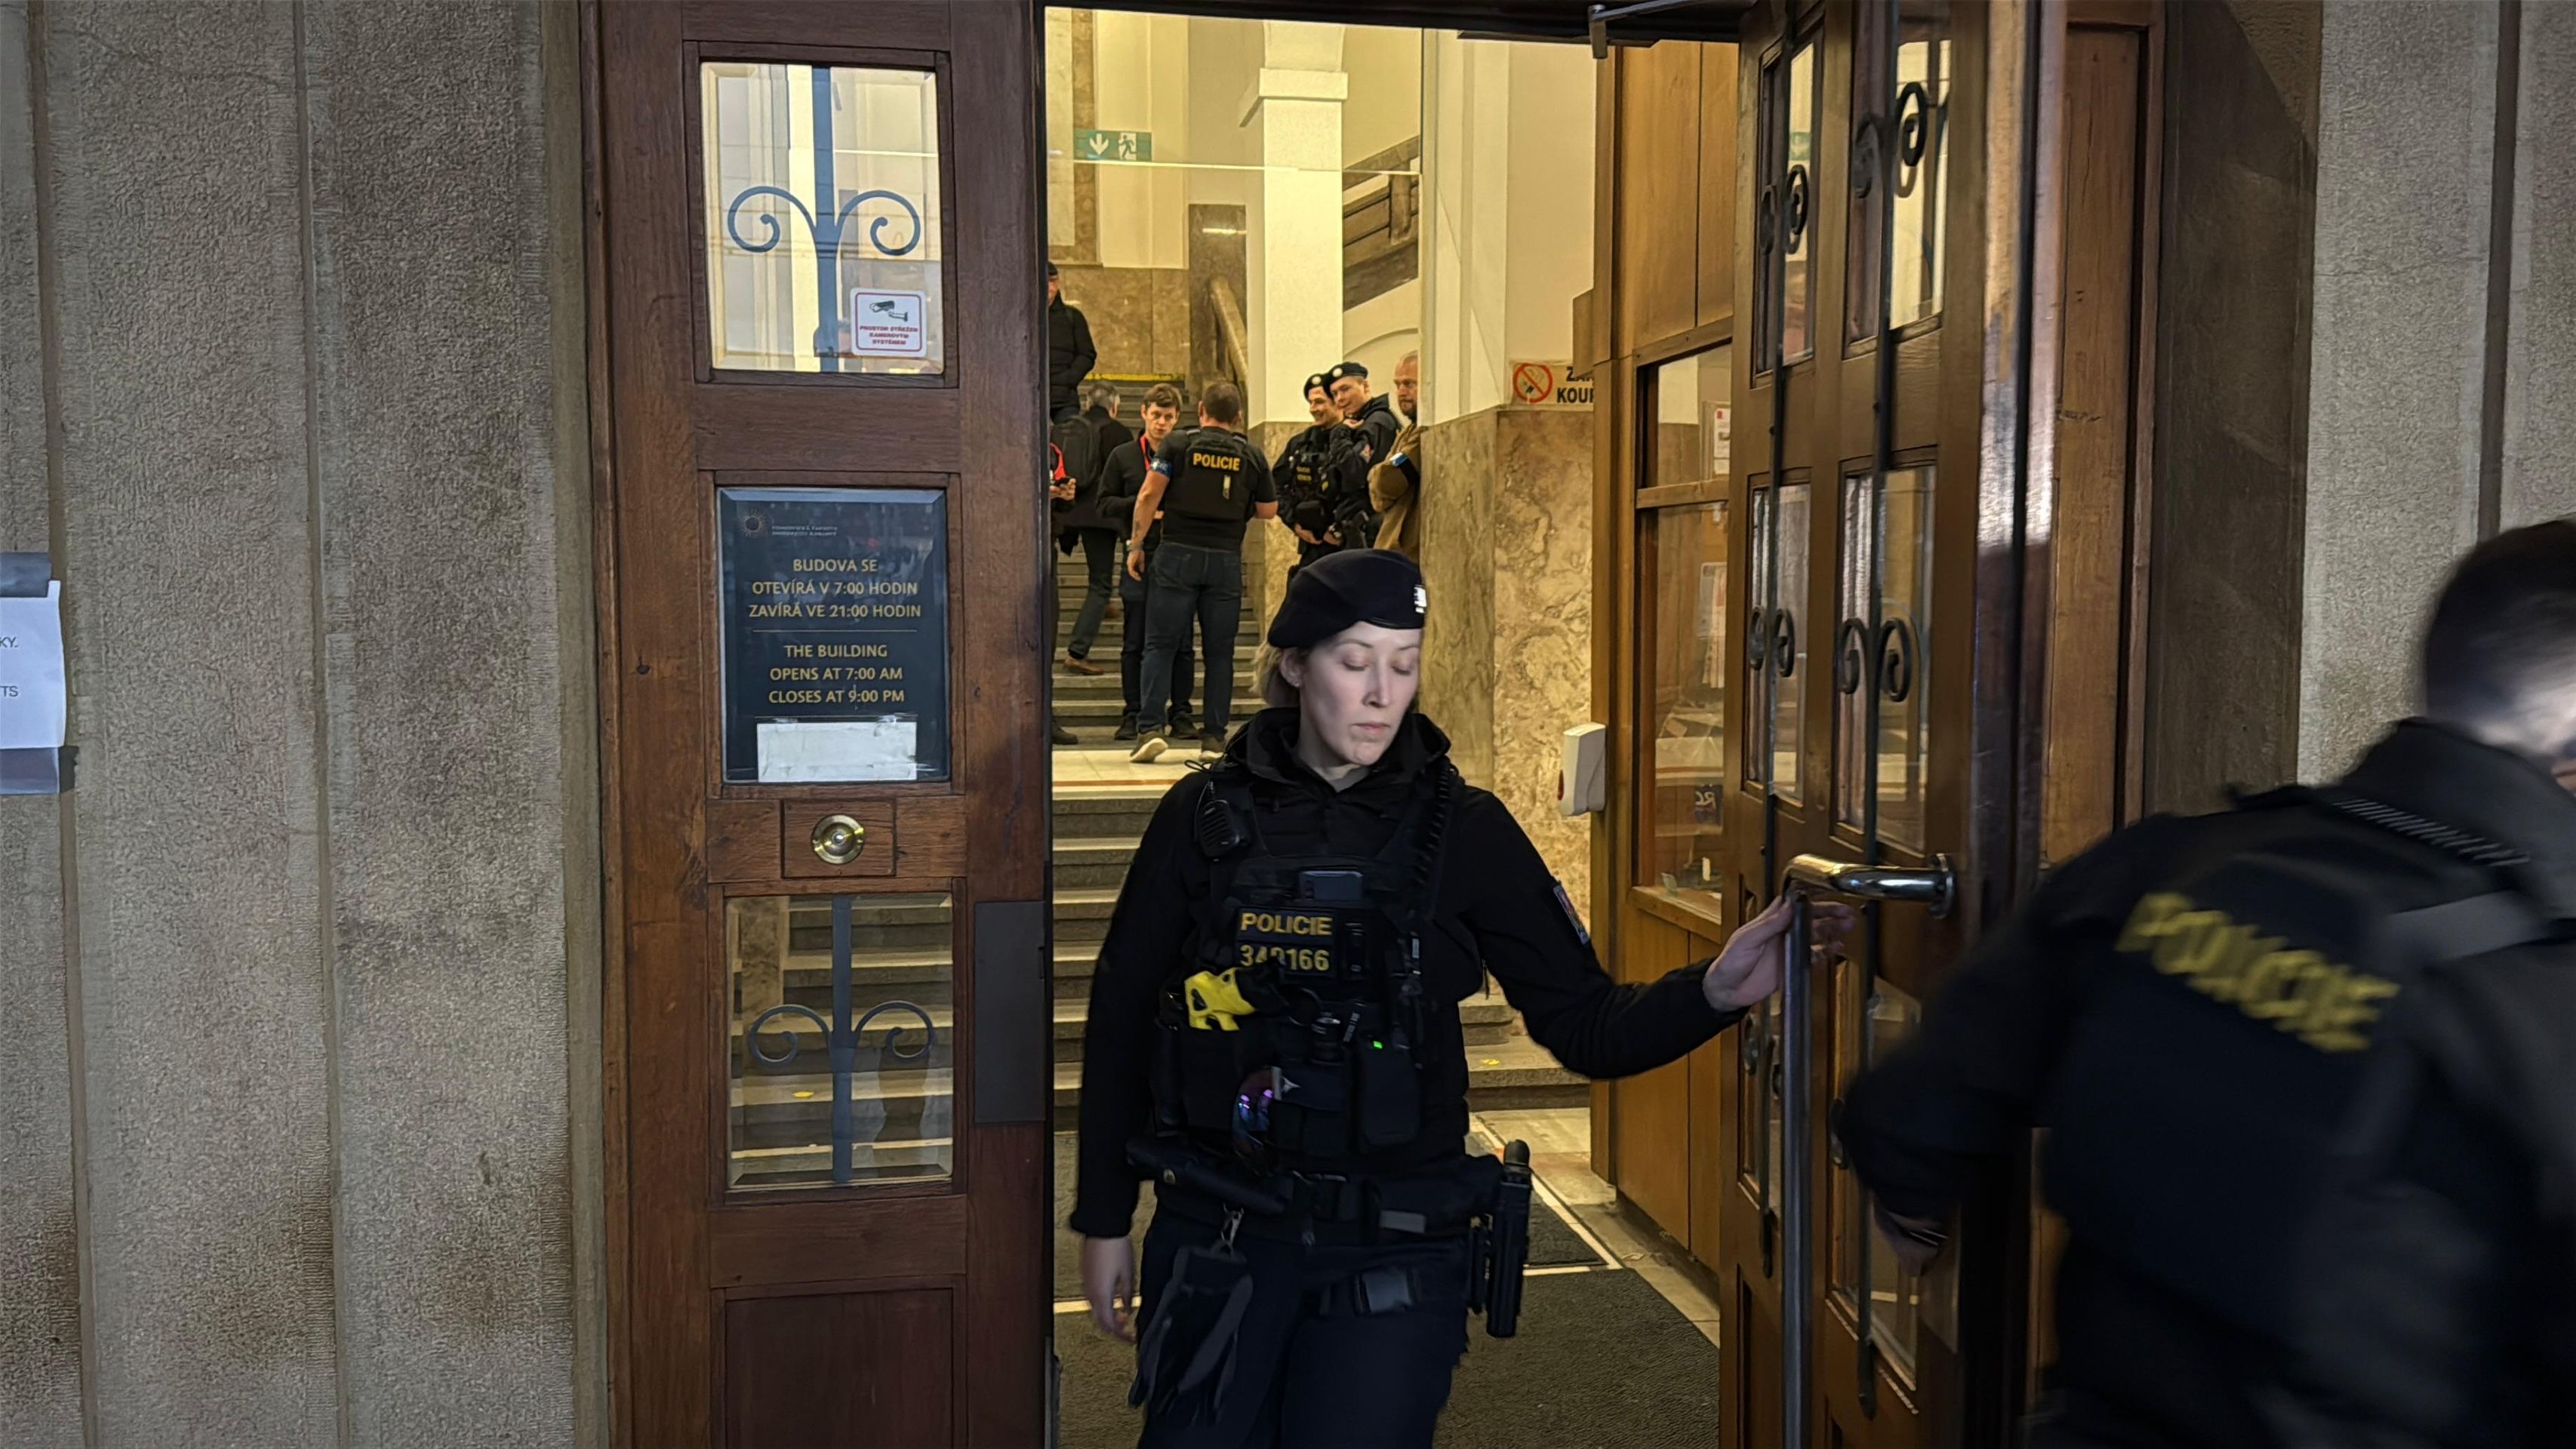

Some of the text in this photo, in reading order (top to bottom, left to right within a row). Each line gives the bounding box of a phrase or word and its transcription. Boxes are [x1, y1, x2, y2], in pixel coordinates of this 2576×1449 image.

[1193, 453, 1241, 471] POLICIE
[792, 558, 879, 572] BUDOVA SE
[752, 580, 919, 595] OTEVÍRÁ V 7:00 HODIN
[749, 603, 922, 618] ZAVÍRÁ VE 21:00 HODIN
[783, 645, 888, 657] THE BUILDING
[769, 667, 903, 680] OPENS AT 7:00 AM
[768, 690, 906, 703] CLOSES AT 9:00 PM
[1240, 912, 1333, 936] POLICIE
[2116, 892, 2402, 1054] POLICIE
